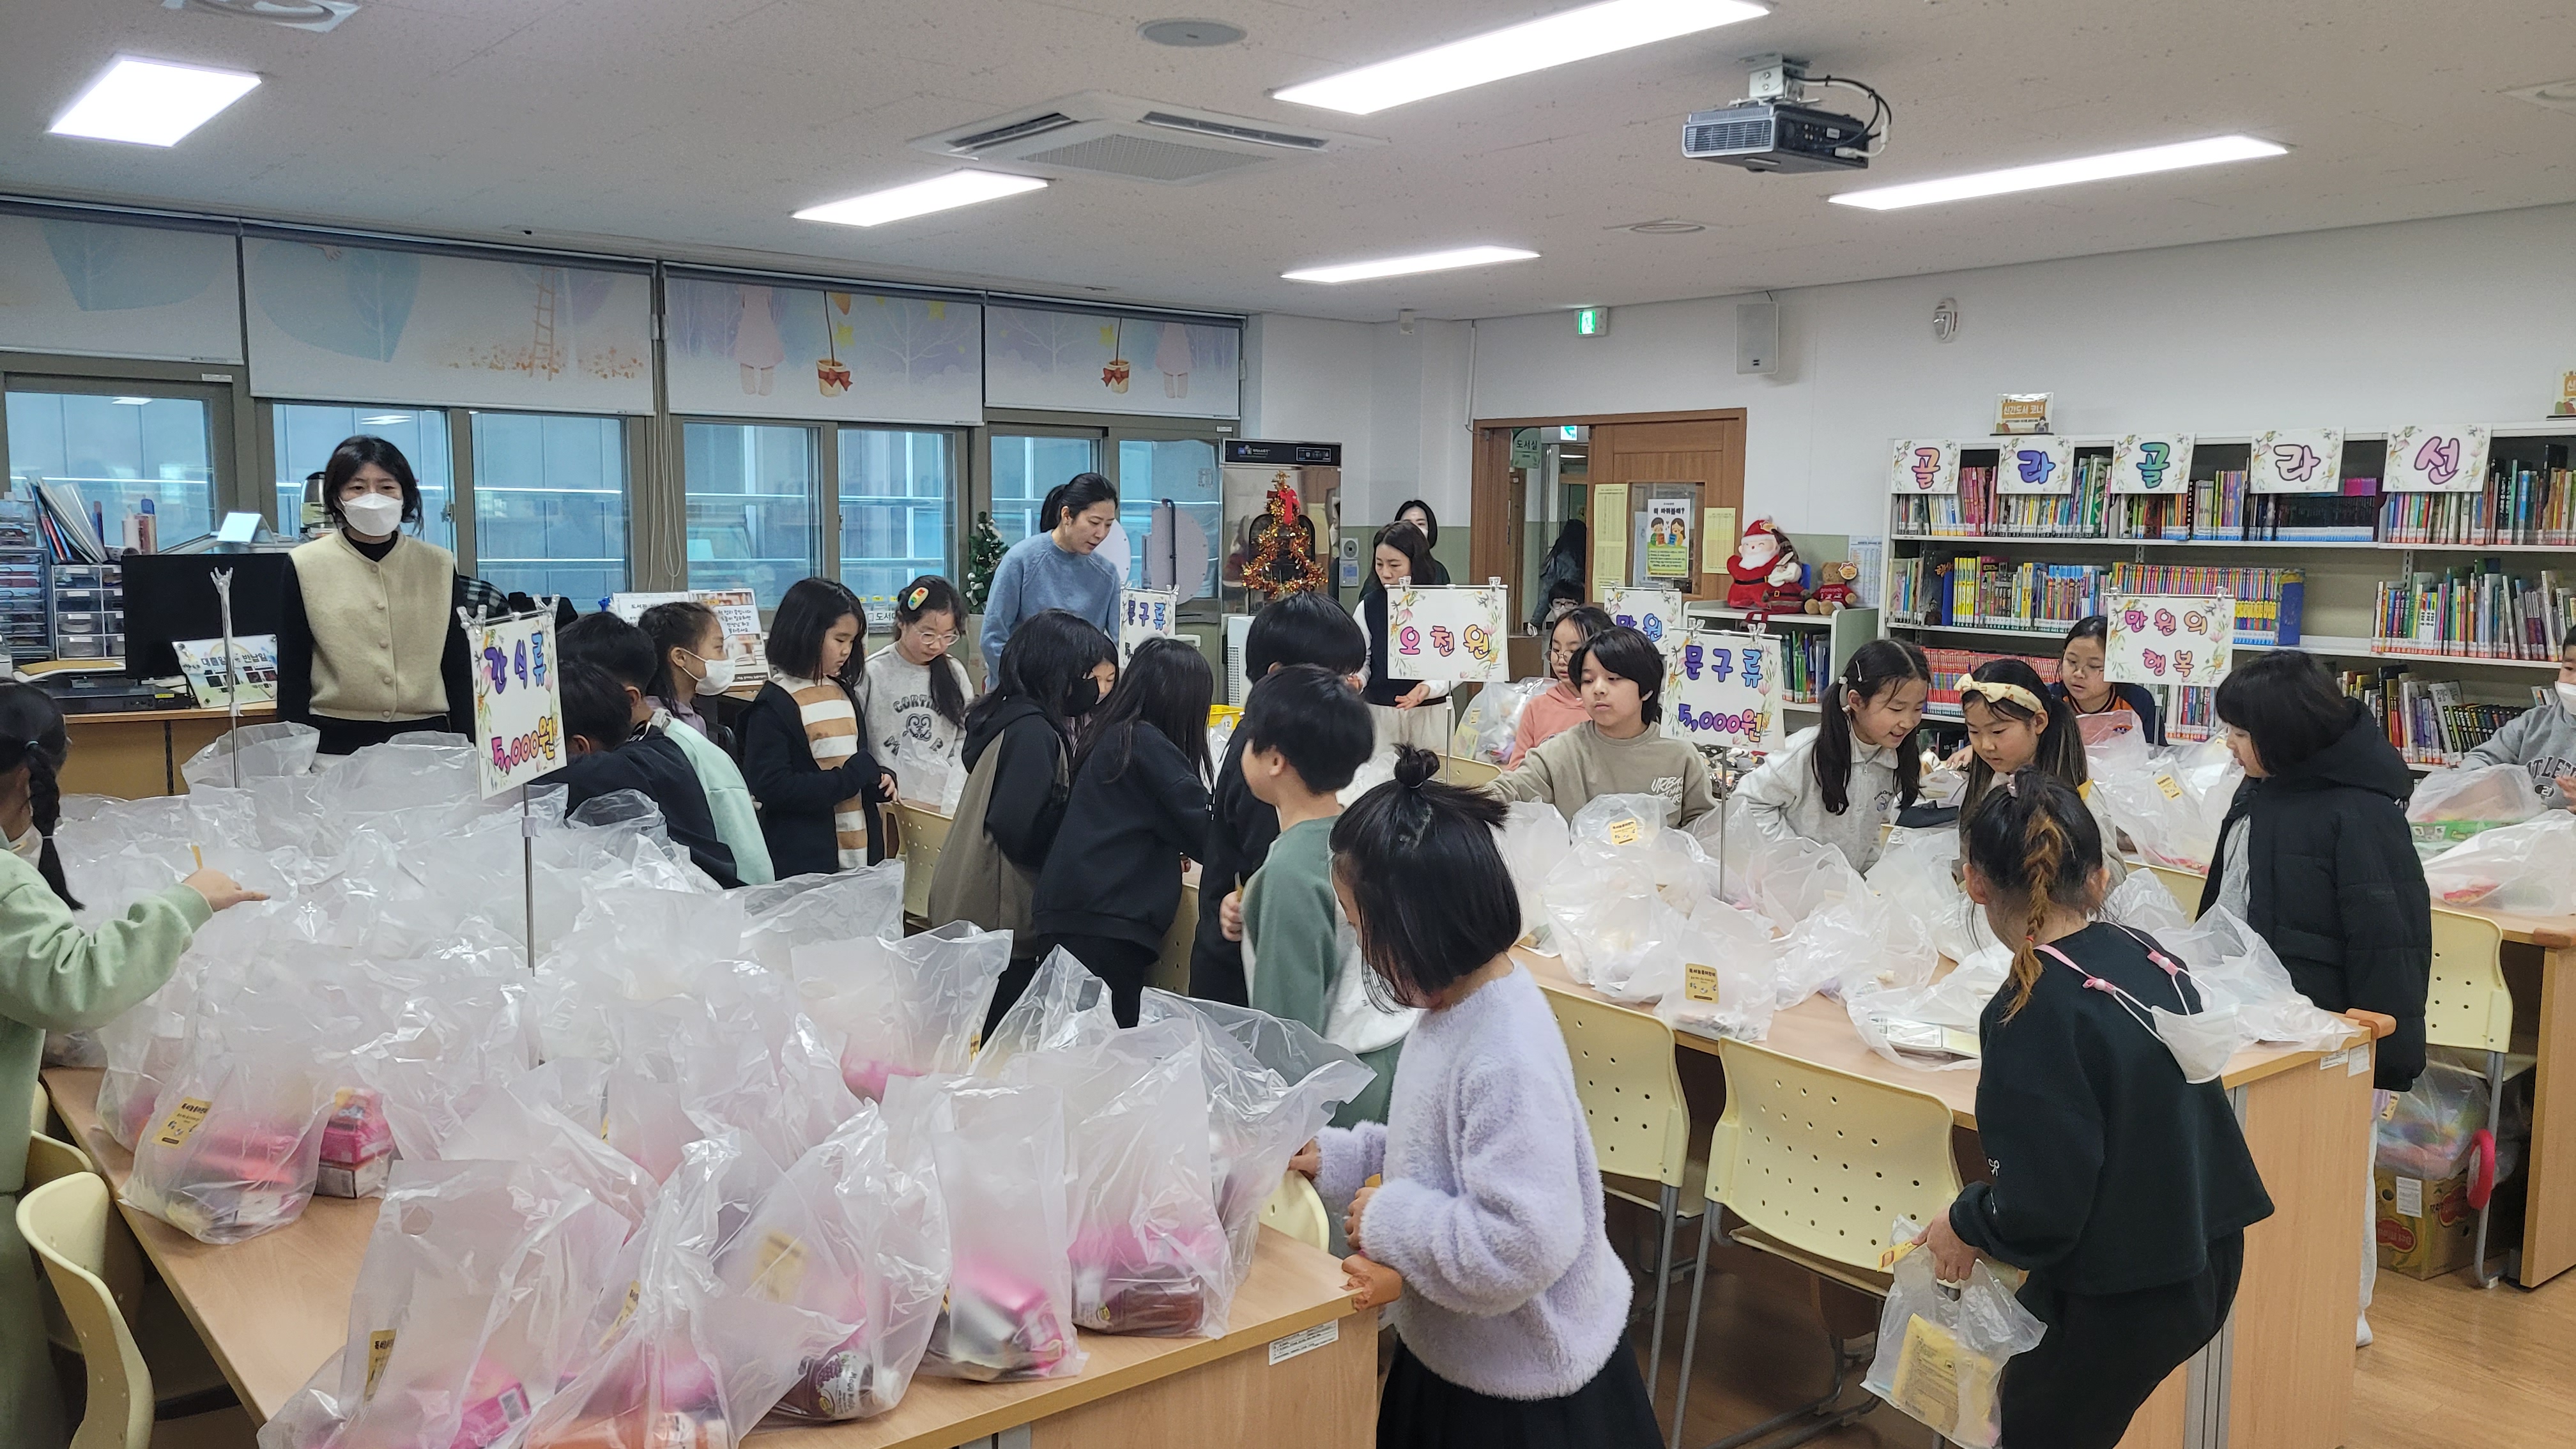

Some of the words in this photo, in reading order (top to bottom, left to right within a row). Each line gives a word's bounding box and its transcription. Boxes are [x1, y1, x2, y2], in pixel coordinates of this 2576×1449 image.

[2004, 405, 2028, 415] 신간도서
[2030, 404, 2044, 414] 코너
[1516, 440, 1537, 450] 도서실
[1912, 447, 1940, 489] 골
[2017, 450, 2056, 484] 라
[2136, 441, 2170, 489] 골
[2273, 444, 2321, 482] 라
[2414, 436, 2460, 485] 선
[1128, 600, 1166, 631] 문구류
[2125, 608, 2208, 636] 만원의
[1399, 624, 1491, 659] 오천원
[484, 632, 546, 694] 간식류
[1685, 645, 1763, 688] 문구류
[2142, 648, 2194, 677] 행복
[1678, 703, 1763, 742] 5,000원
[491, 716, 555, 776] 5,000원
